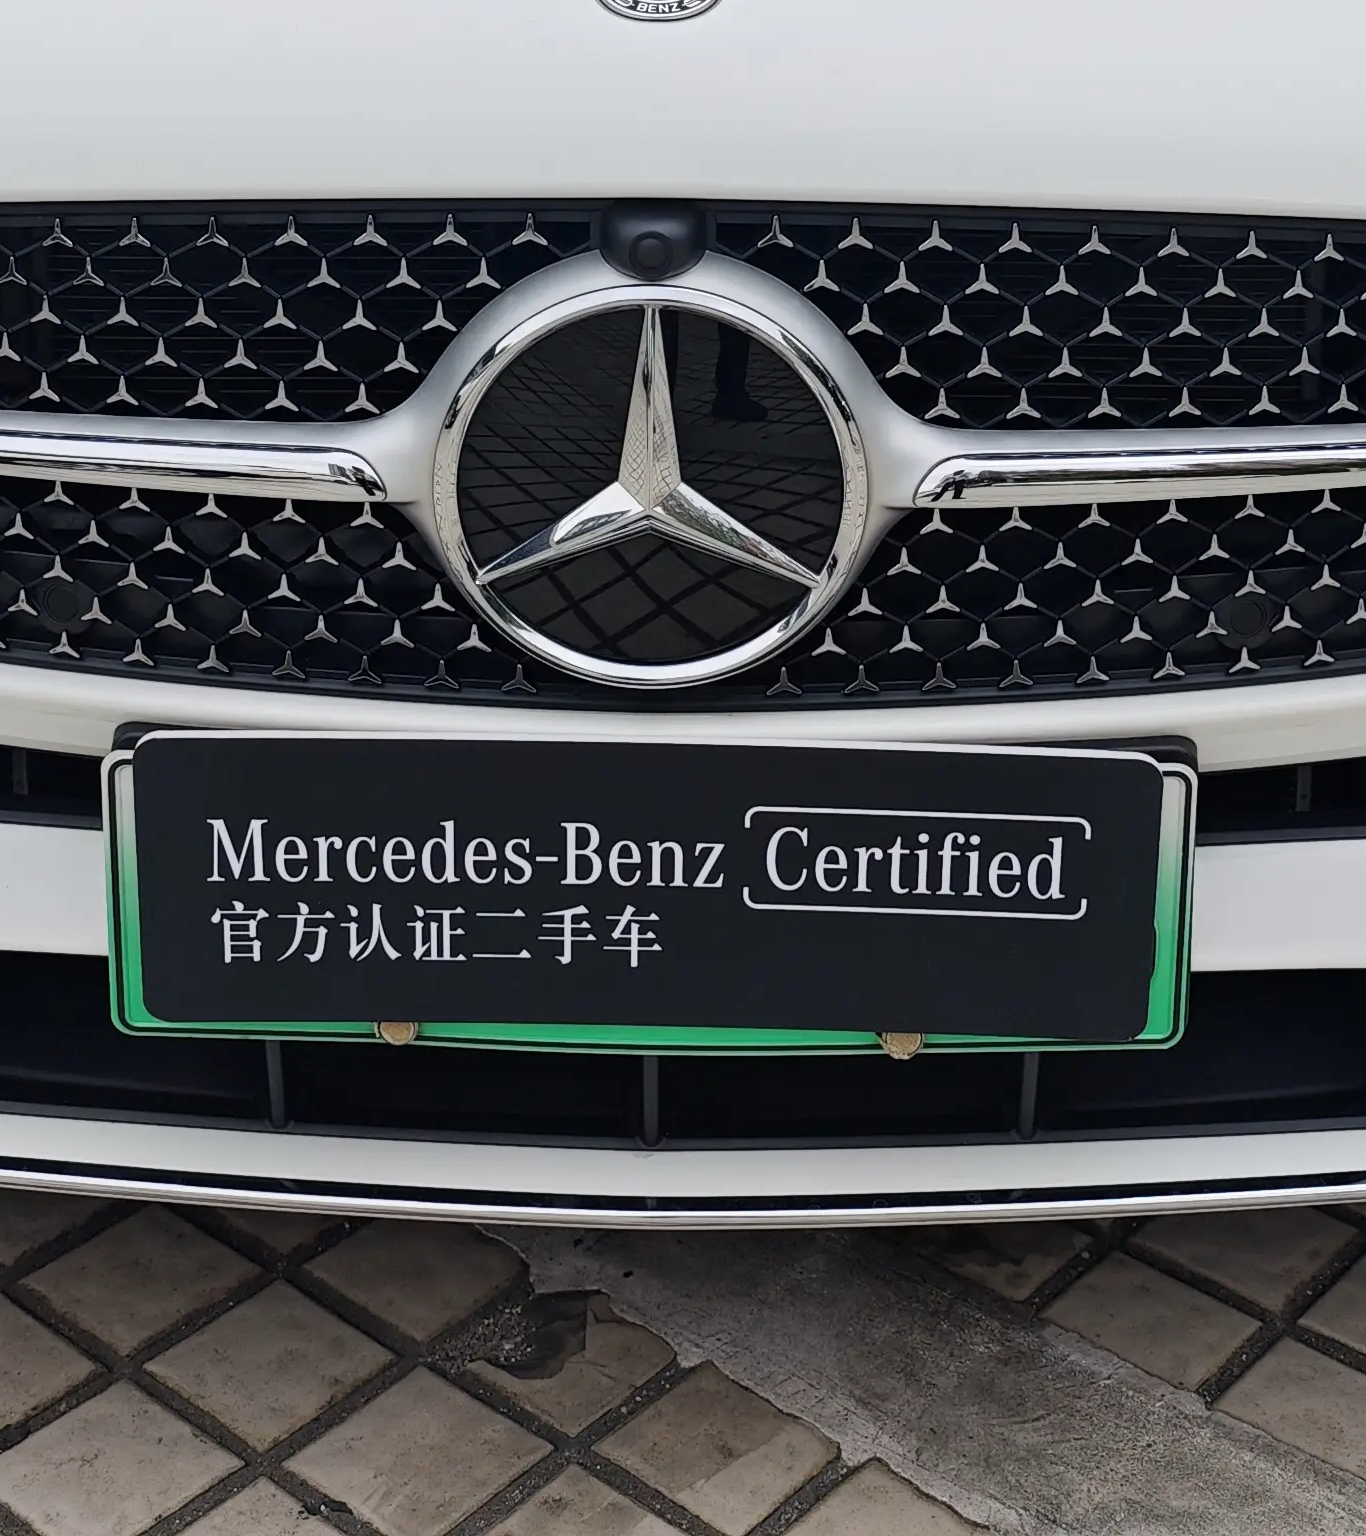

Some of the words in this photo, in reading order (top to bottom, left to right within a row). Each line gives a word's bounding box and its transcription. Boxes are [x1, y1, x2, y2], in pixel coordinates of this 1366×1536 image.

[636, 1, 681, 13] BENZ
[206, 818, 725, 889] Mercedes-Benz
[766, 826, 1065, 900] Certified
[210, 900, 662, 968] 官方认证二手车
